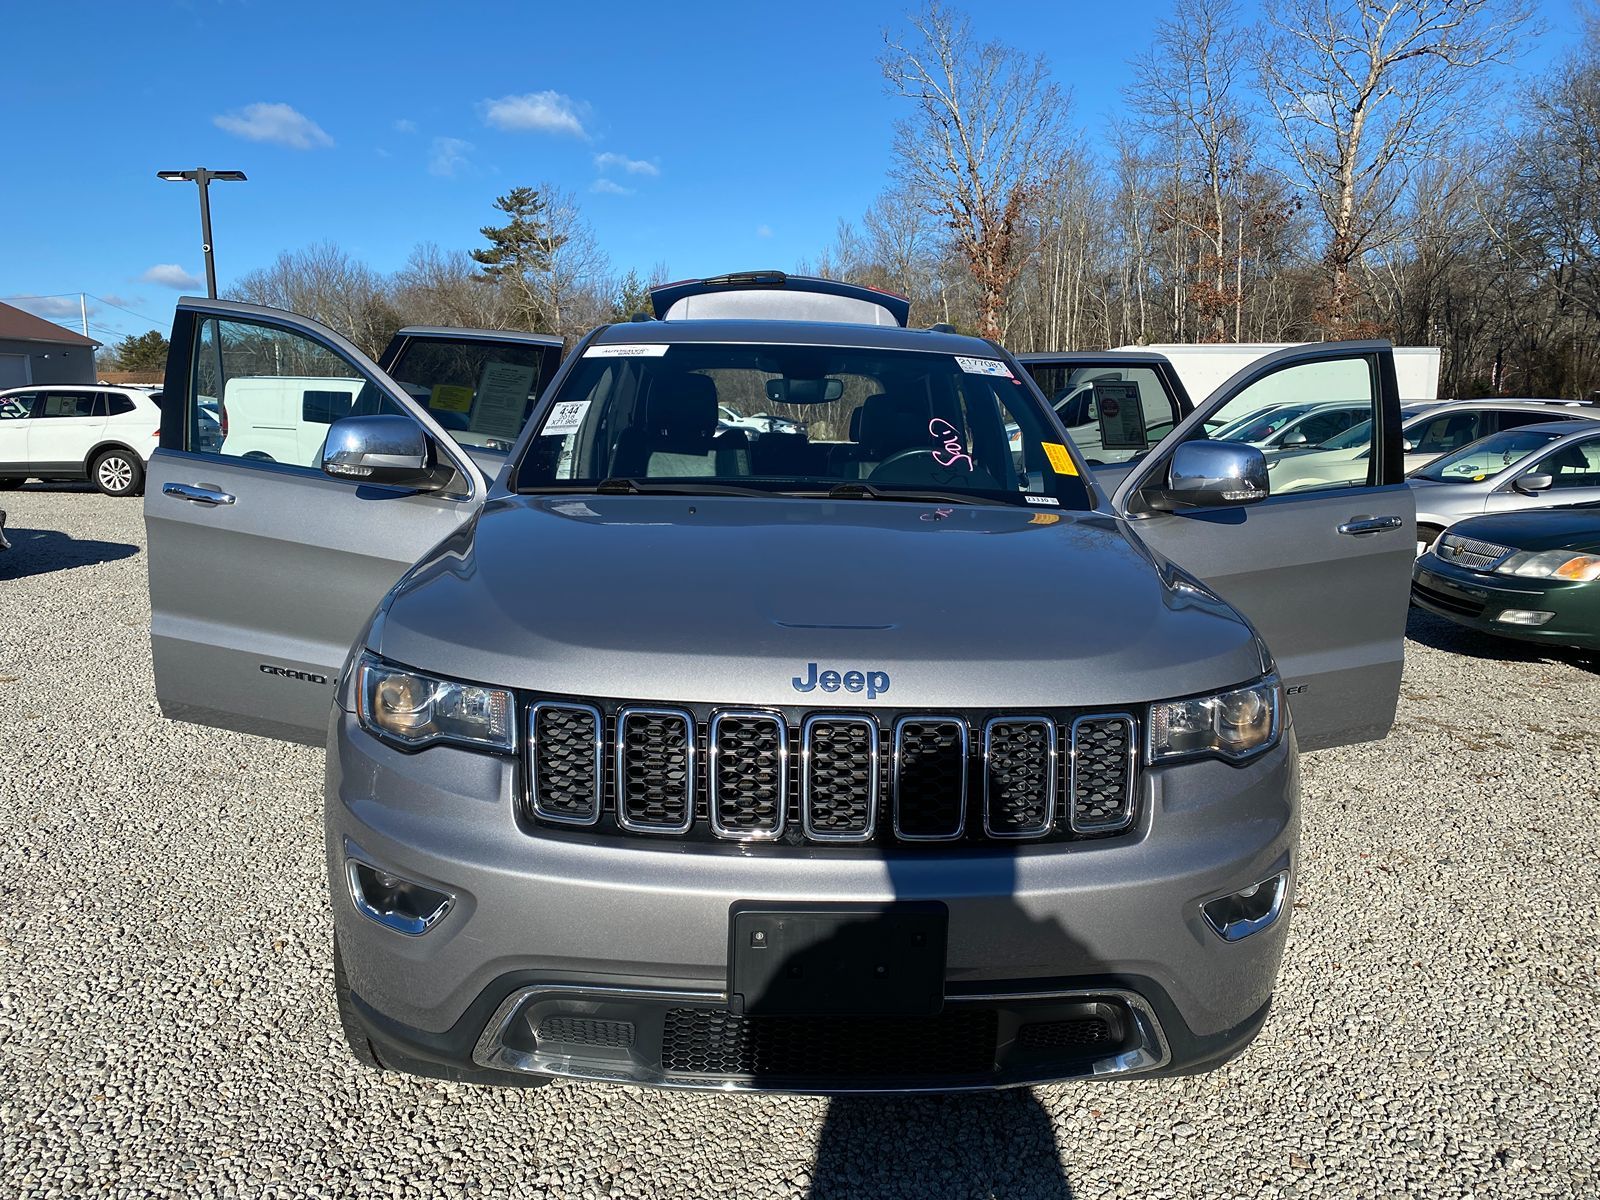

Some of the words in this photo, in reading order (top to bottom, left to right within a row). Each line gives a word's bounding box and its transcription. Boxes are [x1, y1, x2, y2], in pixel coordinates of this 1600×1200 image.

[958, 358, 1004, 369] 2177081
[259, 664, 328, 685] GRAND
[792, 663, 890, 699] Jeep
[1286, 684, 1309, 695] EE
